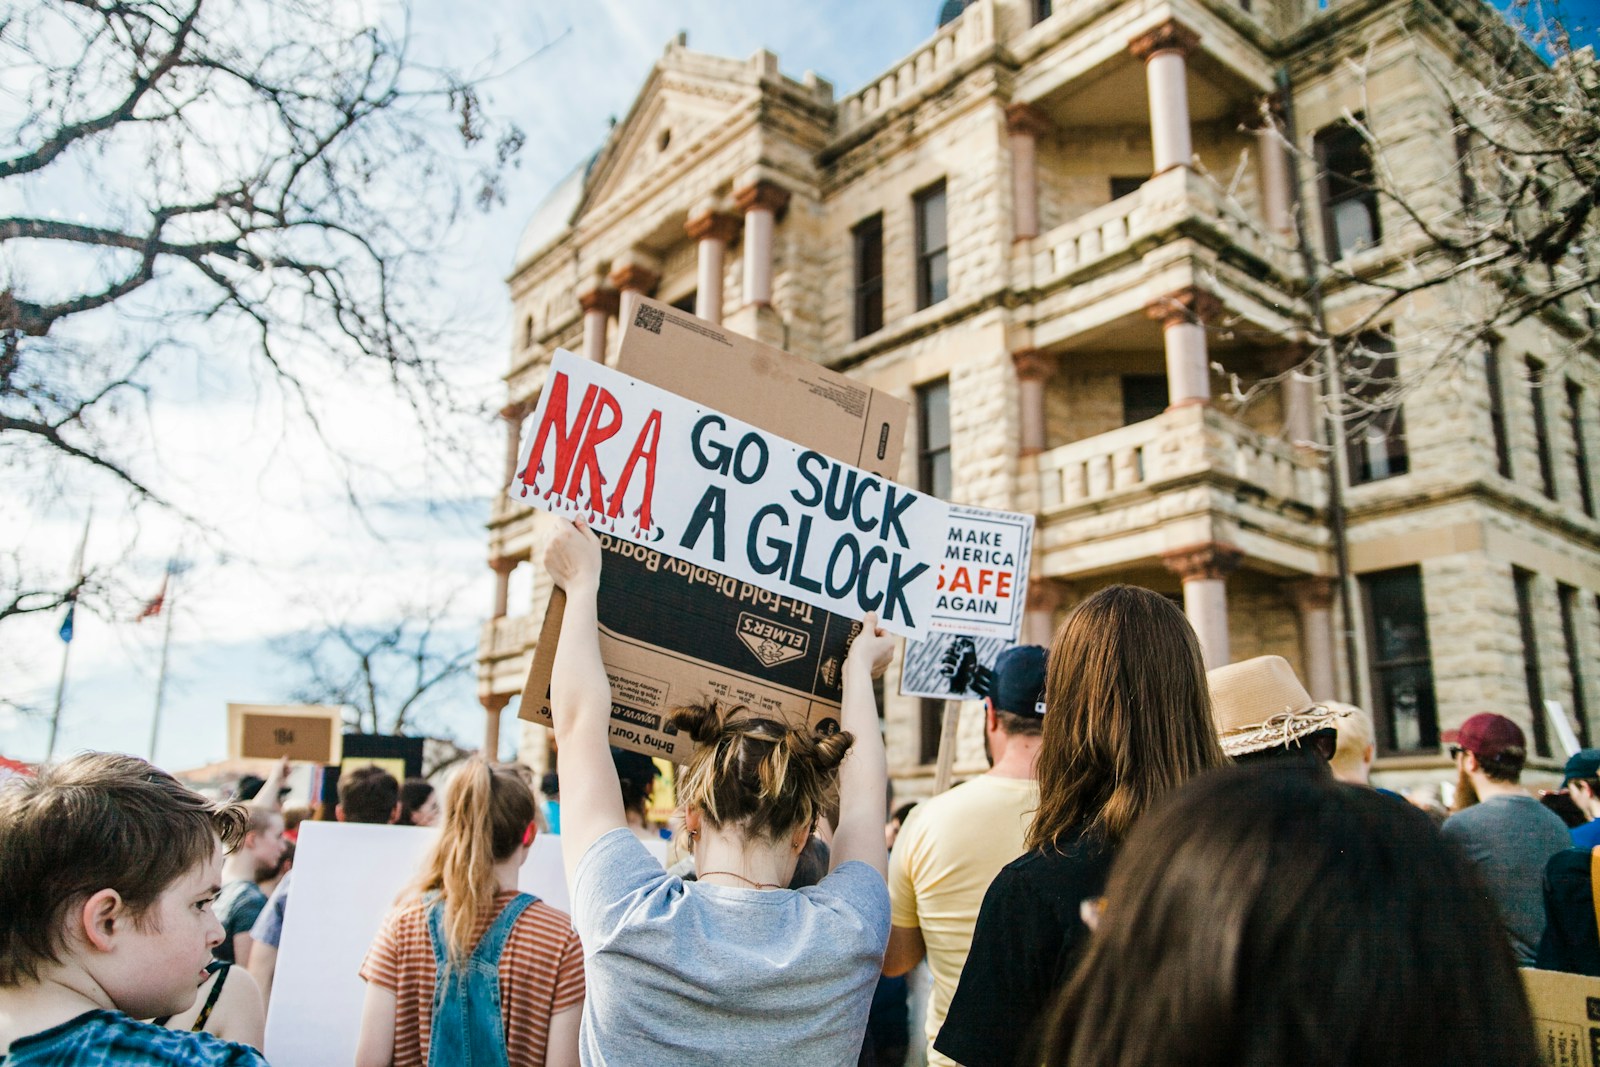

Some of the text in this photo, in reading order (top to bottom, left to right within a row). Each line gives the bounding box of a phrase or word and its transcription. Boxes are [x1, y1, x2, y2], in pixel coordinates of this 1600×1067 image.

[691, 415, 918, 549] GO SUCK
[947, 526, 1002, 547] MAKE
[679, 484, 930, 628] A GLOCK
[945, 545, 1014, 566] MERICA
[936, 595, 997, 614] AGAIN
[742, 618, 804, 647] ELMER'S
[613, 727, 641, 745] Your
[644, 734, 675, 754] Bring
